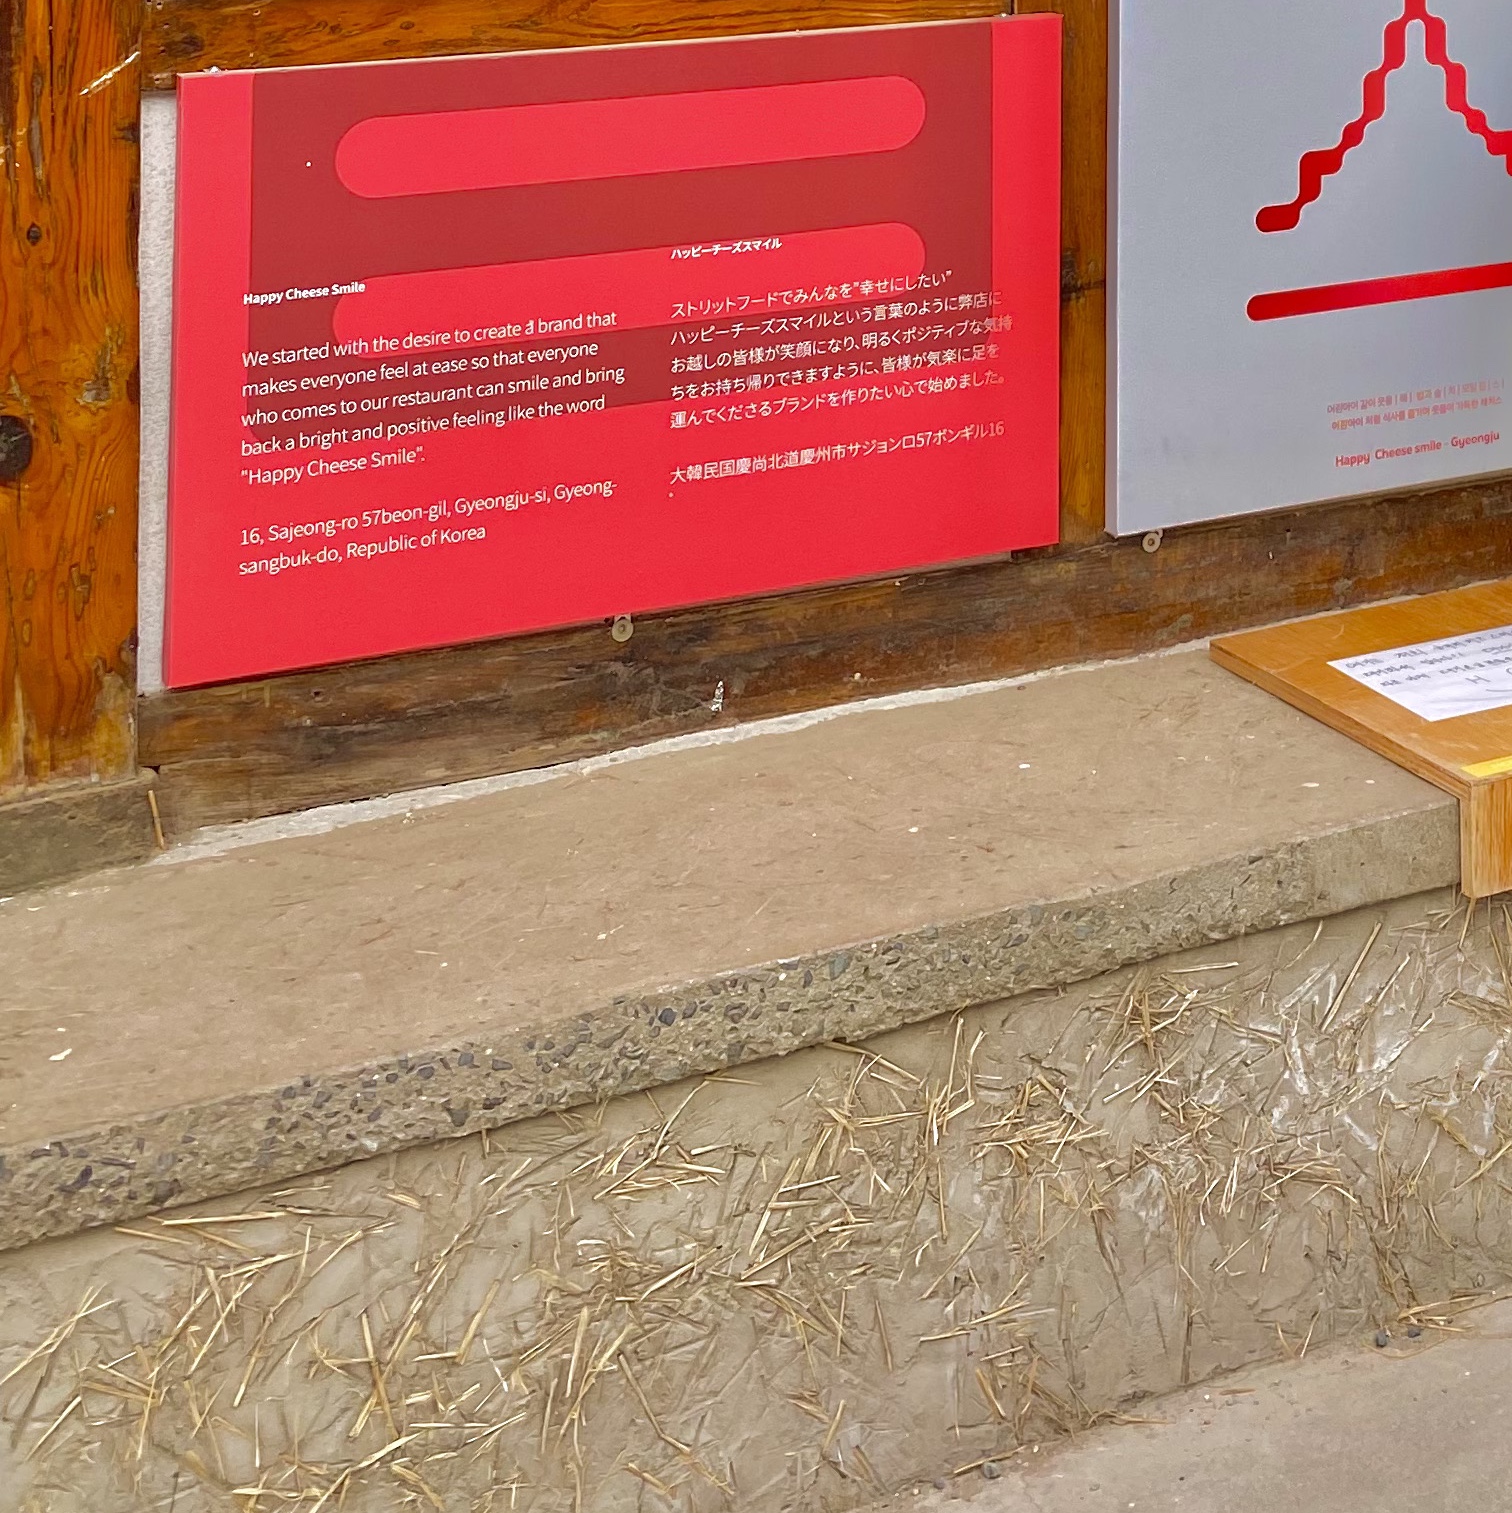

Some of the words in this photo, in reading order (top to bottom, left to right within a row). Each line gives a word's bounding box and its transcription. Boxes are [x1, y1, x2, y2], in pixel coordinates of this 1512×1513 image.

[670, 237, 782, 260] ハッピーチーズスマイル
[242, 290, 284, 305] Happy
[285, 284, 330, 301] Cheese
[331, 280, 366, 295] Smile
[241, 350, 269, 368] We
[272, 342, 330, 366] started
[332, 338, 369, 358] with
[372, 335, 400, 353] the
[402, 330, 452, 350] desire
[454, 326, 471, 345] to
[474, 322, 522, 342] create
[538, 314, 584, 333] brand
[585, 311, 618, 329] that
[241, 378, 297, 397] makes
[300, 367, 377, 391] everyone
[379, 363, 410, 380] feel
[412, 361, 429, 376] at
[431, 358, 468, 375] ease
[471, 355, 490, 370] so
[492, 350, 524, 368] that
[526, 341, 599, 366] everyone
[240, 407, 278, 427] who
[281, 401, 338, 424] comes
[340, 397, 357, 414] to
[360, 394, 389, 412] our
[392, 385, 473, 408] restaurant
[476, 381, 504, 399] can
[507, 374, 549, 395] smile
[552, 371, 583, 389] and
[585, 366, 626, 387] bring
[240, 436, 282, 457] back
[299, 427, 349, 451] bright
[351, 423, 383, 441] and
[386, 414, 450, 440] positive
[452, 408, 505, 430] feeling
[507, 404, 535, 422] like
[538, 401, 564, 419] the
[566, 395, 606, 416] word
[1335, 452, 1371, 467] Happy
[1375, 446, 1413, 460] Cheese
[1451, 430, 1500, 448] Gyeongju
[307, 455, 368, 479] Cheese
[240, 528, 265, 547] 16,
[267, 515, 359, 544] Sajeong-ro
[361, 500, 452, 528] 57beon-gil,
[454, 485, 551, 515] Gyeongju-si,
[553, 479, 618, 502] Gyeong-
[238, 547, 343, 576] sangbuk-do,
[346, 533, 418, 559] Republic
[420, 530, 438, 547] of
[440, 525, 486, 544] Korea
